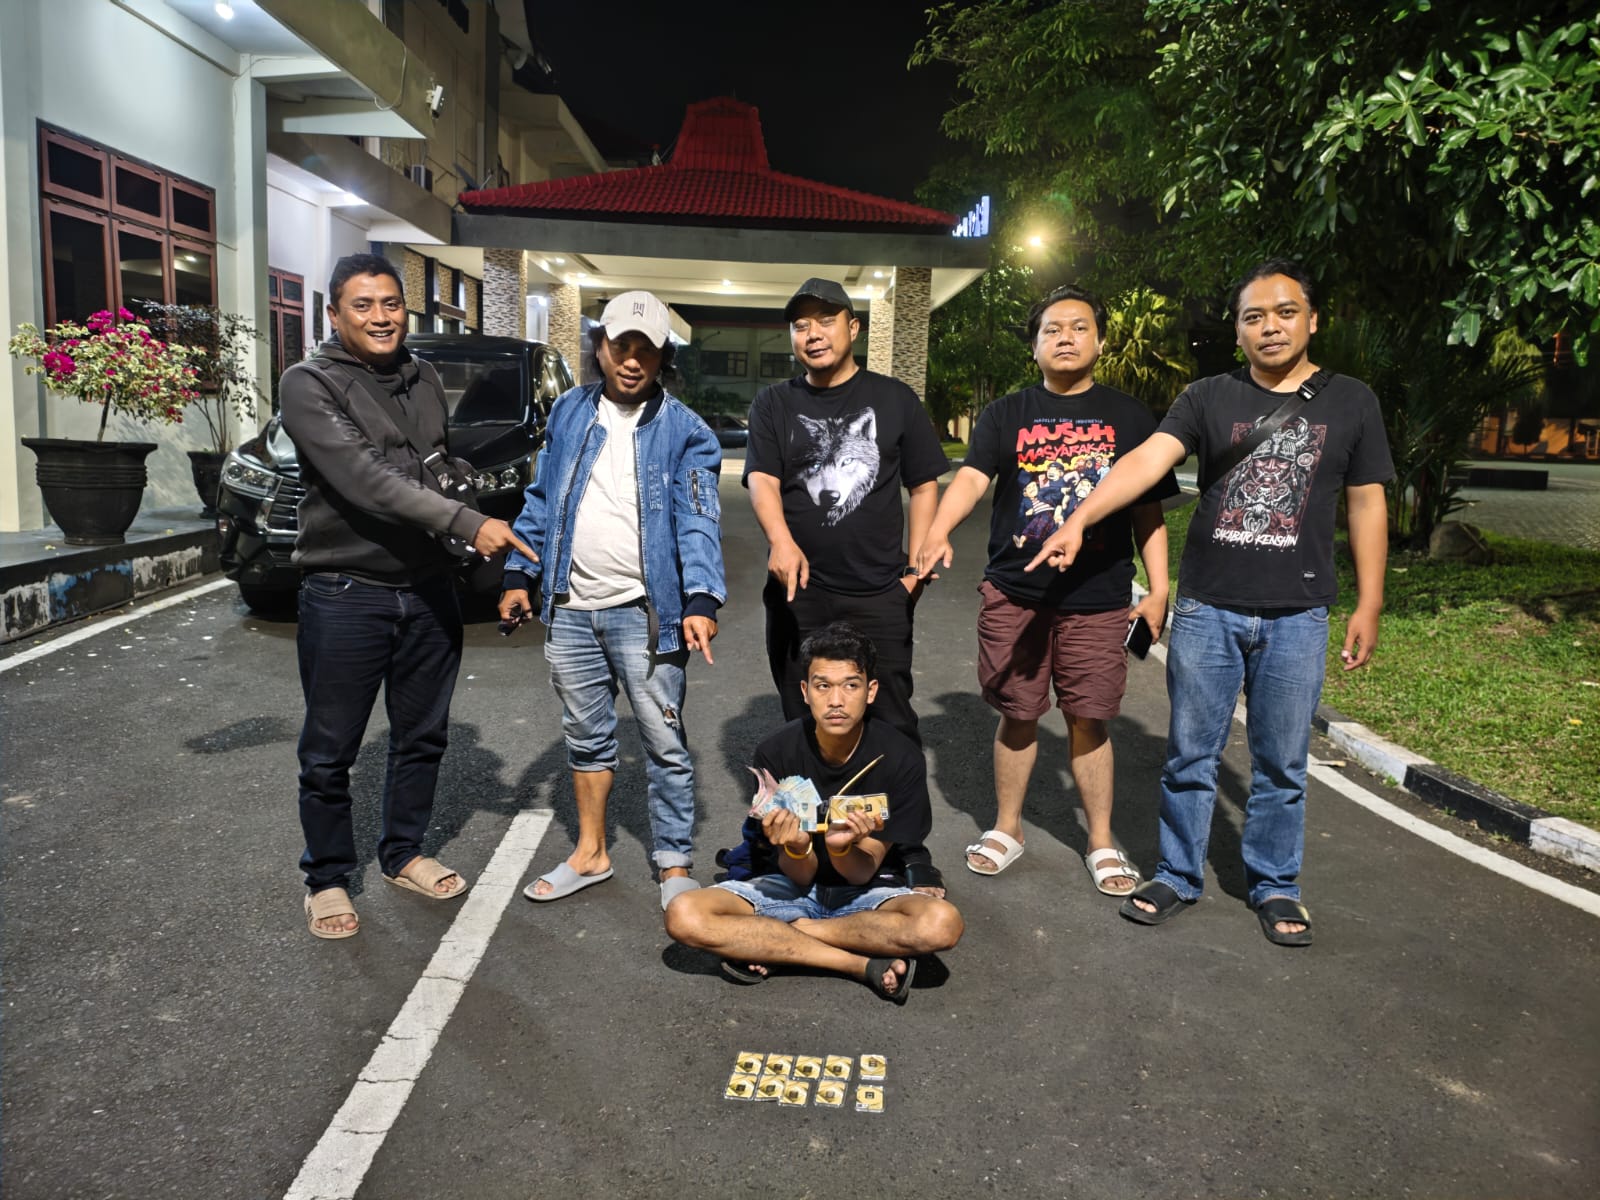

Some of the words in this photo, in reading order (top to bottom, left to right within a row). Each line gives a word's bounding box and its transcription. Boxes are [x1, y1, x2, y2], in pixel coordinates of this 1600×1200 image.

[1015, 422, 1116, 452] MUSUH
[1017, 443, 1116, 463] MASYARAKAT
[1212, 527, 1254, 544] SAKABATO
[1255, 531, 1299, 547] KENSHIN
